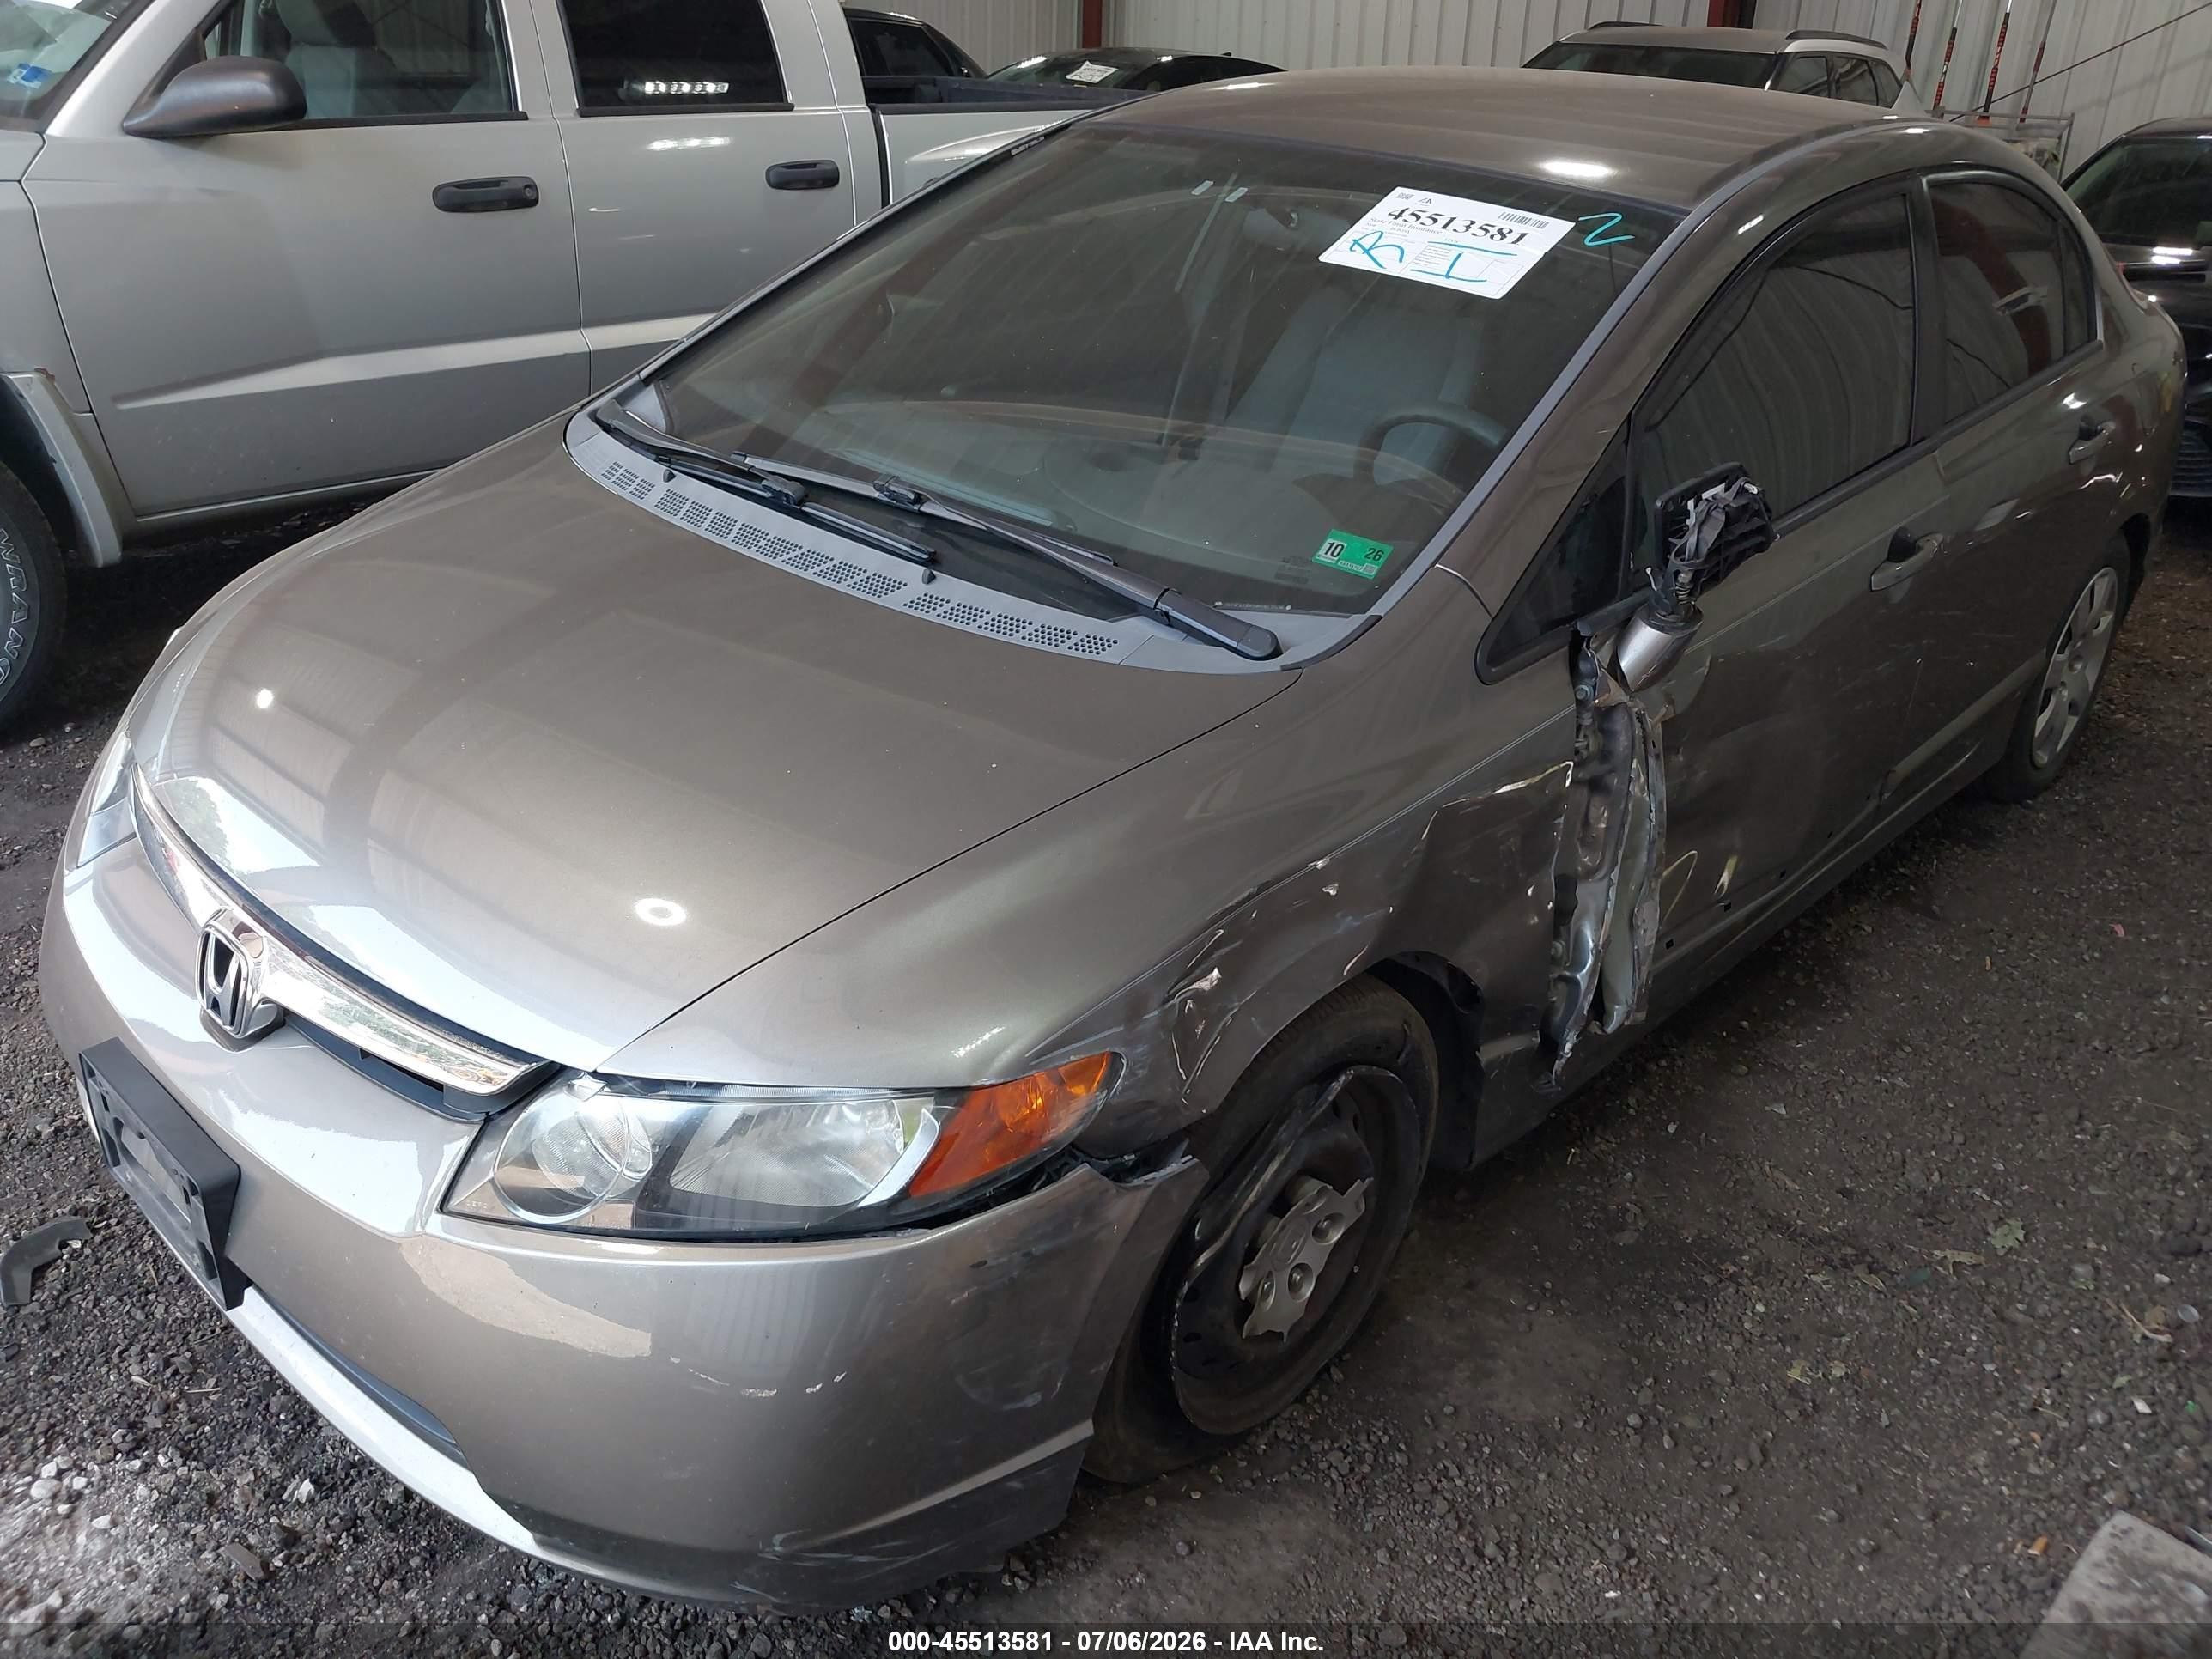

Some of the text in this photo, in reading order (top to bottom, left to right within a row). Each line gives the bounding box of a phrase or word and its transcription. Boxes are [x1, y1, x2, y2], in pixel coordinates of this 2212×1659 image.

[1388, 207, 1529, 244] 45513581
[1324, 541, 1345, 558] 10
[1364, 547, 1384, 562] 26
